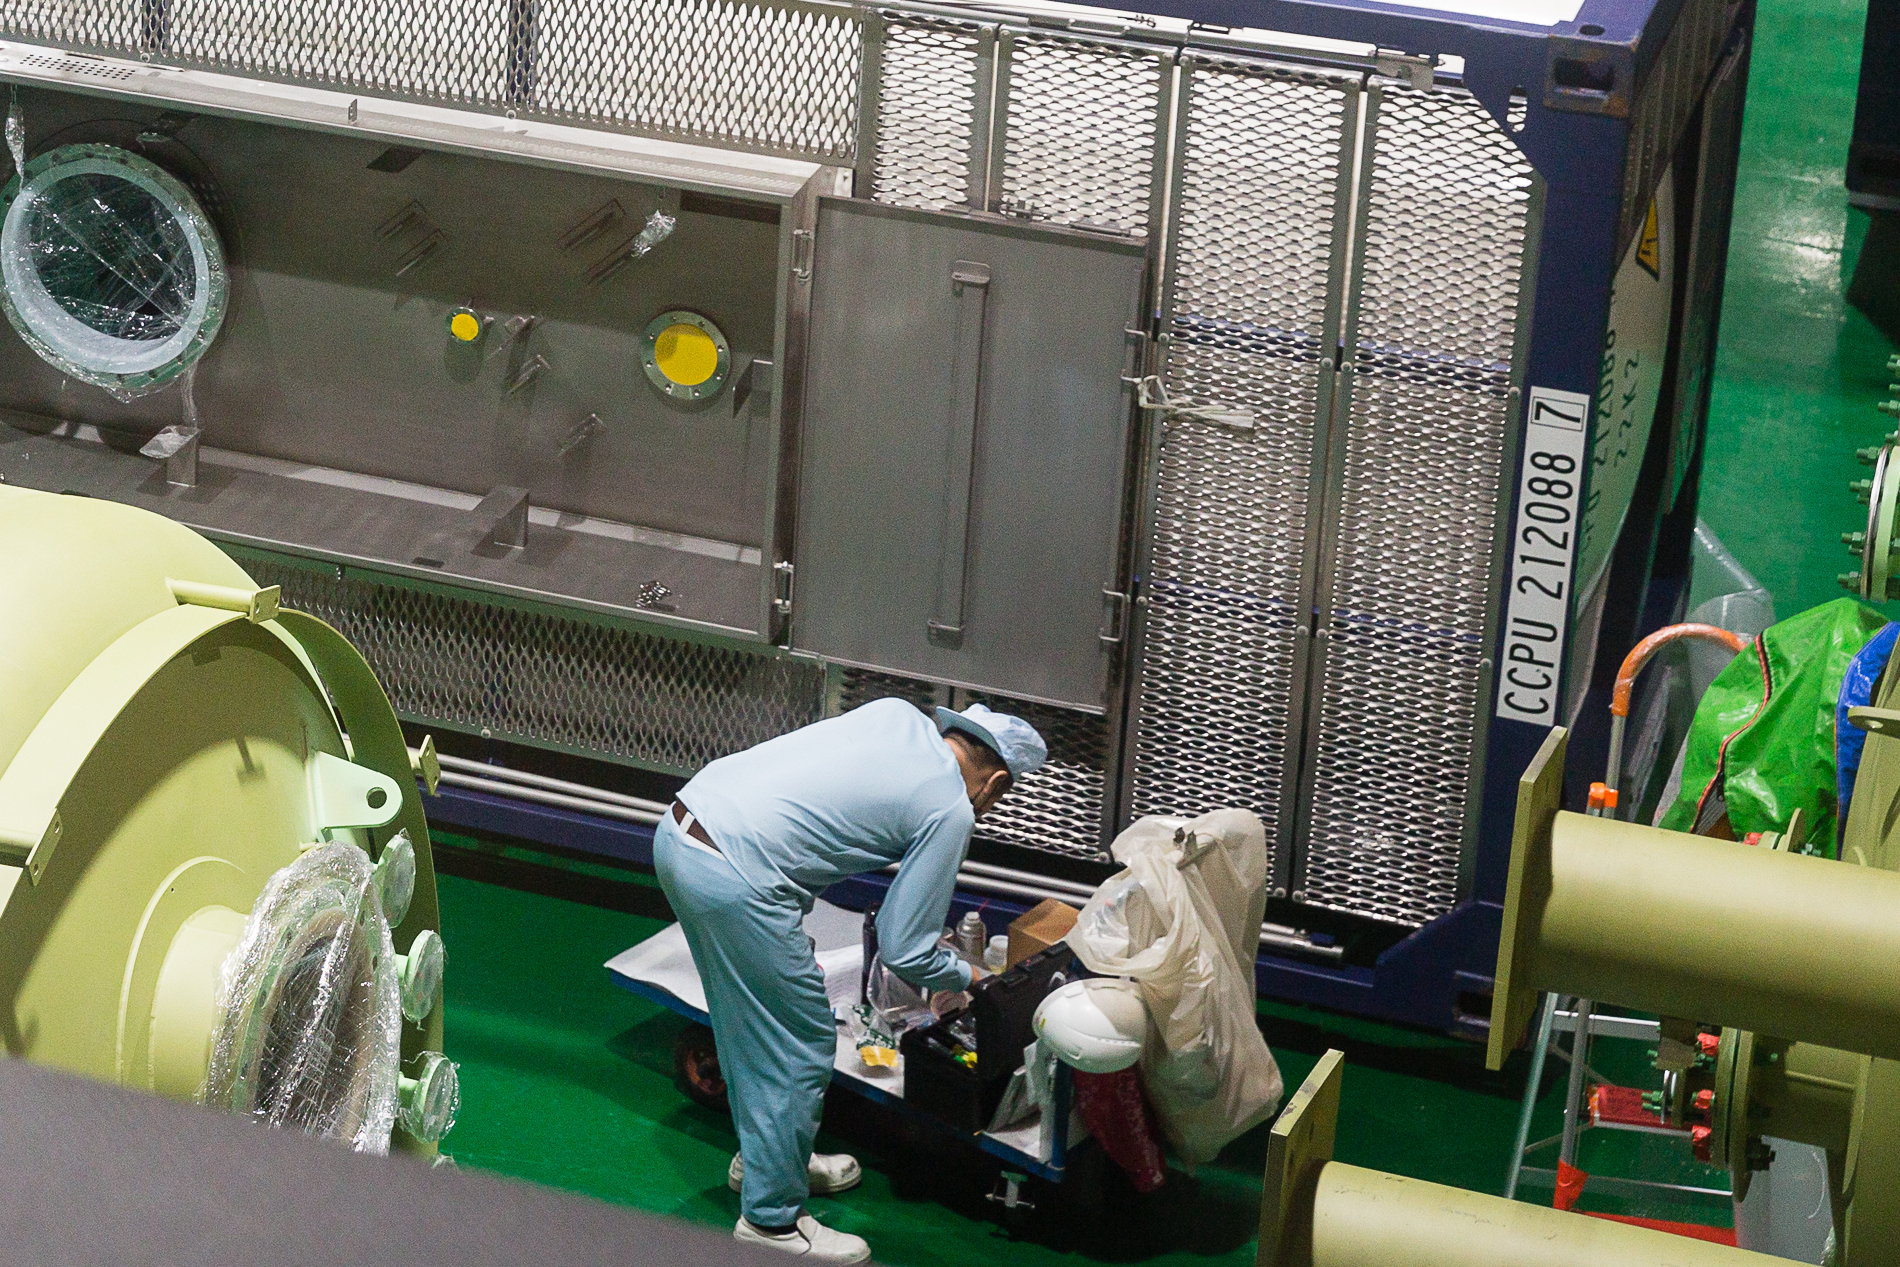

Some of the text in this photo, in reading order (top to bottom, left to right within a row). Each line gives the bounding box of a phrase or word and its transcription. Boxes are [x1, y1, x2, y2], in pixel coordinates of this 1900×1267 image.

[1504, 401, 1581, 715] CCPU 212088 7
